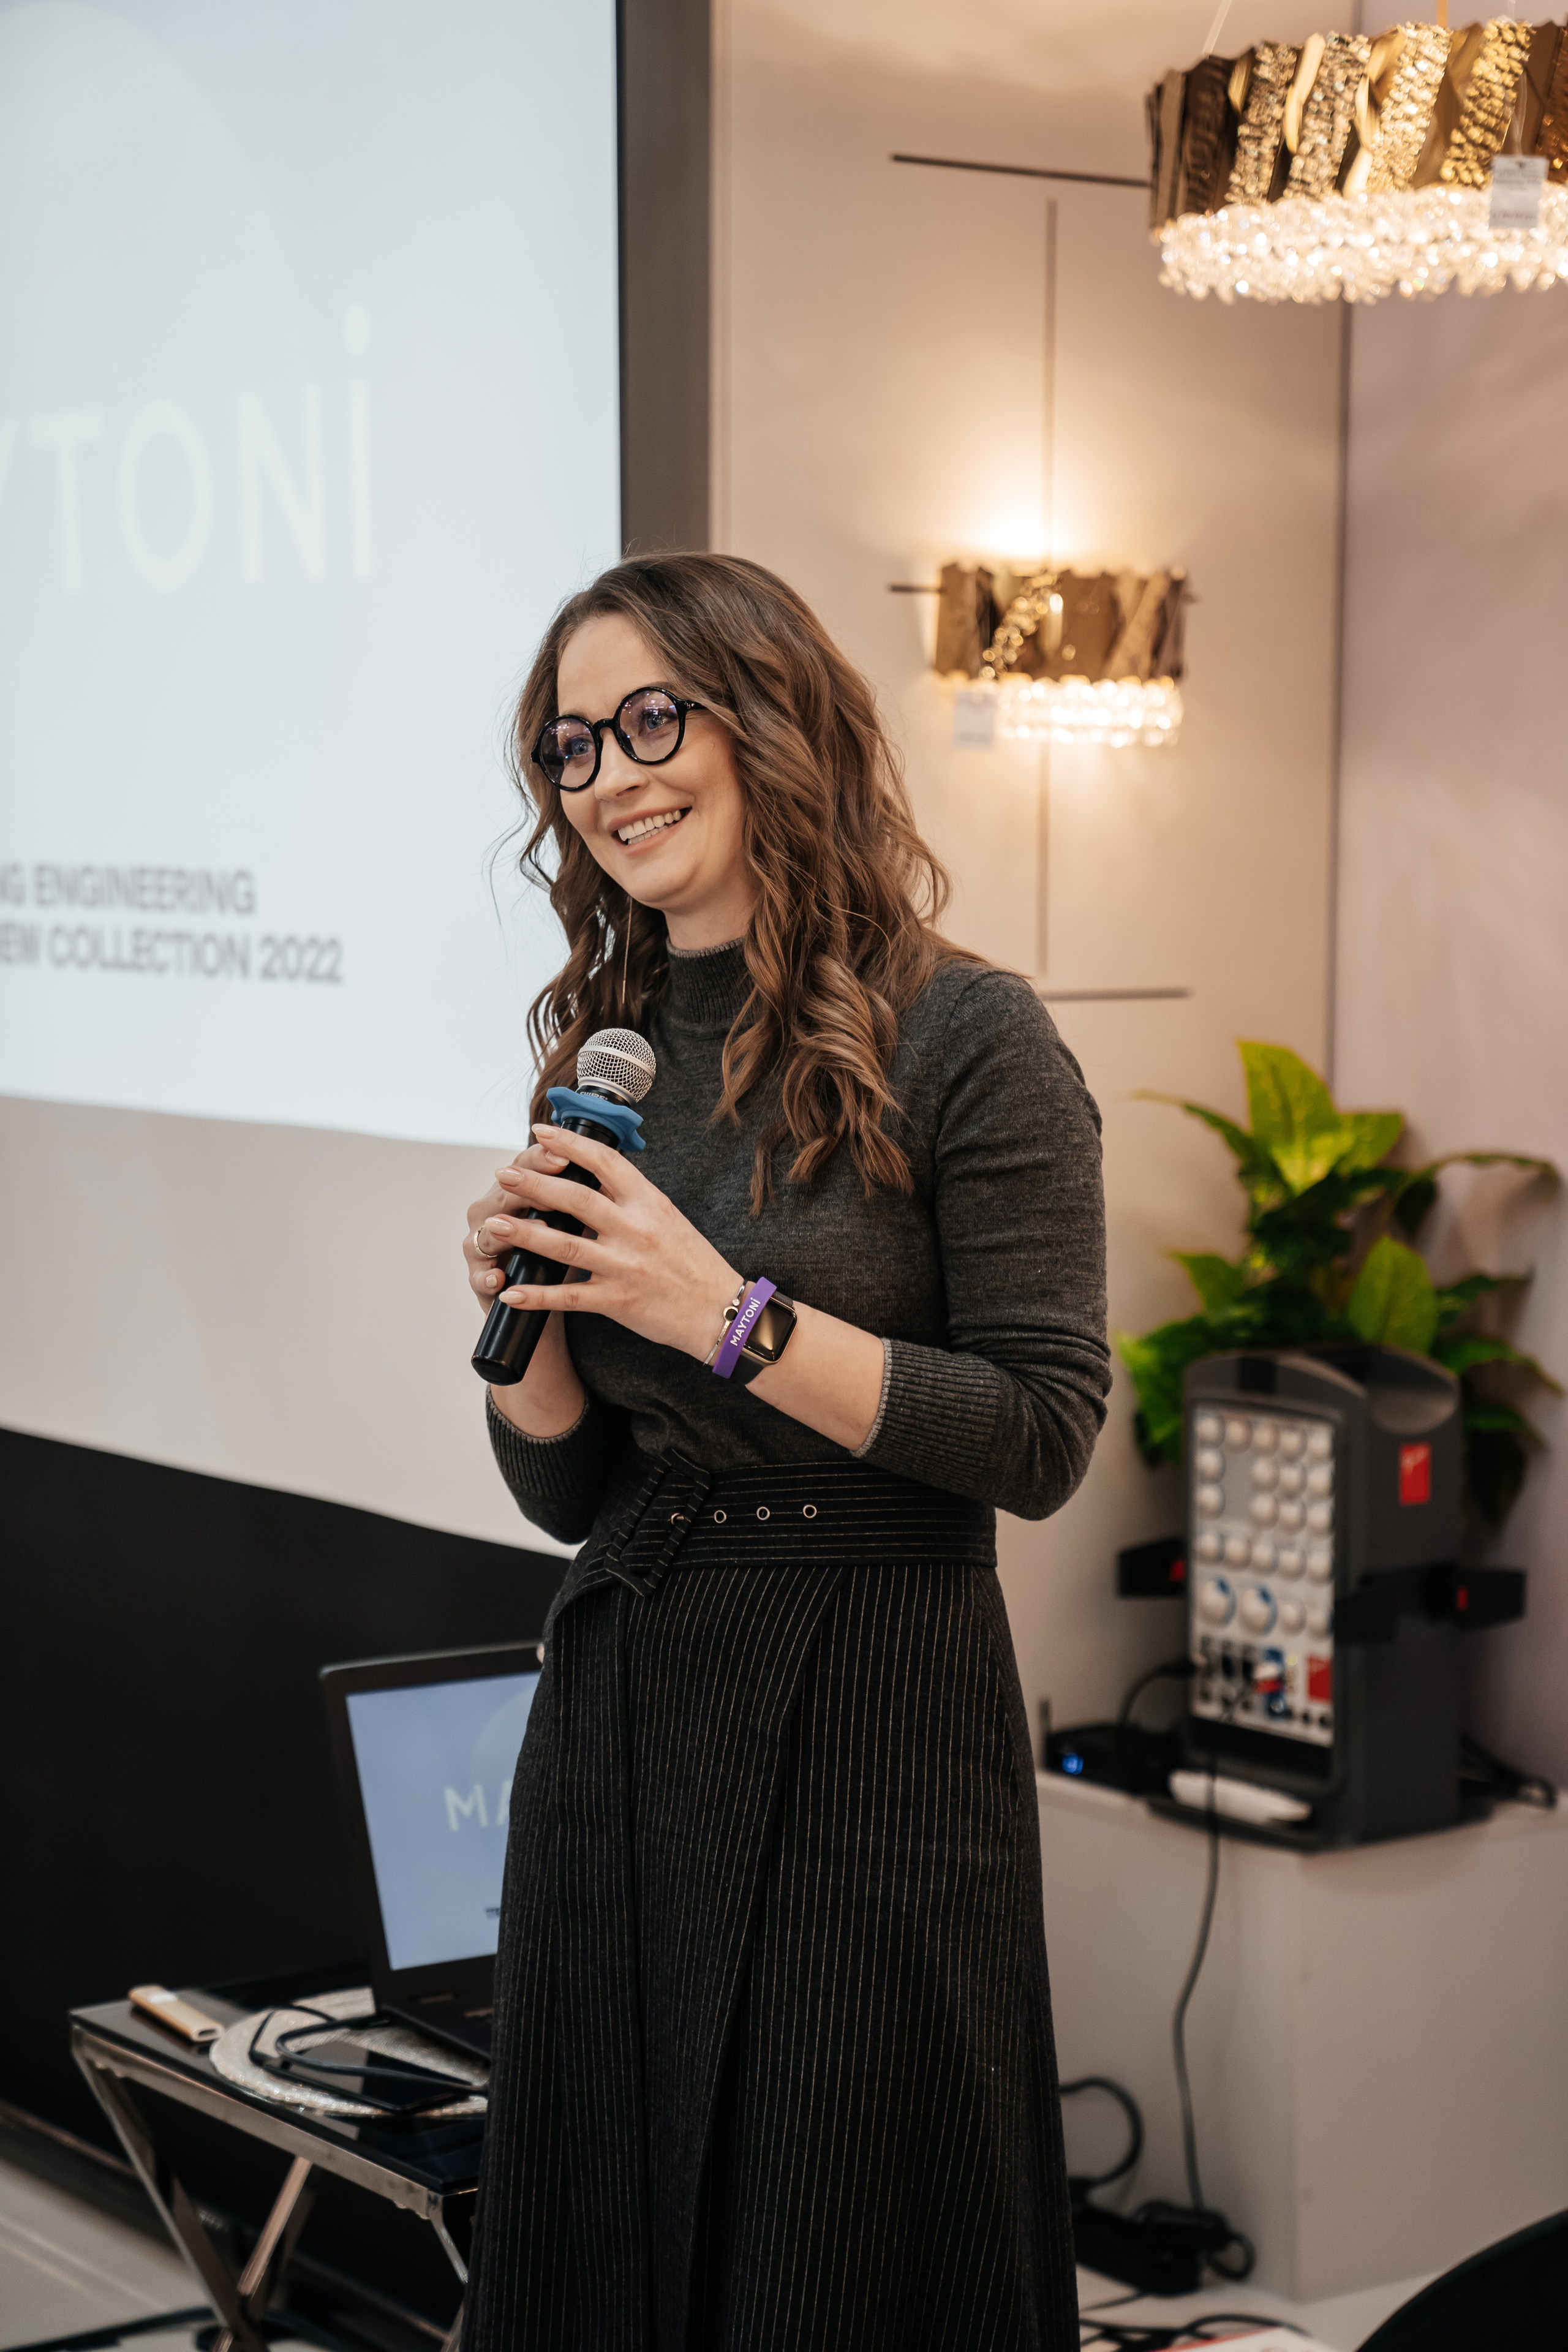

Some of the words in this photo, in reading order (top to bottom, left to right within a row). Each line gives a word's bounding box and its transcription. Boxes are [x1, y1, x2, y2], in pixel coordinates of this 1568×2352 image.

[35, 864, 255, 915] ENGINEERING
[50, 924, 252, 979] COLLECTION
[258, 933, 344, 985] 2022
